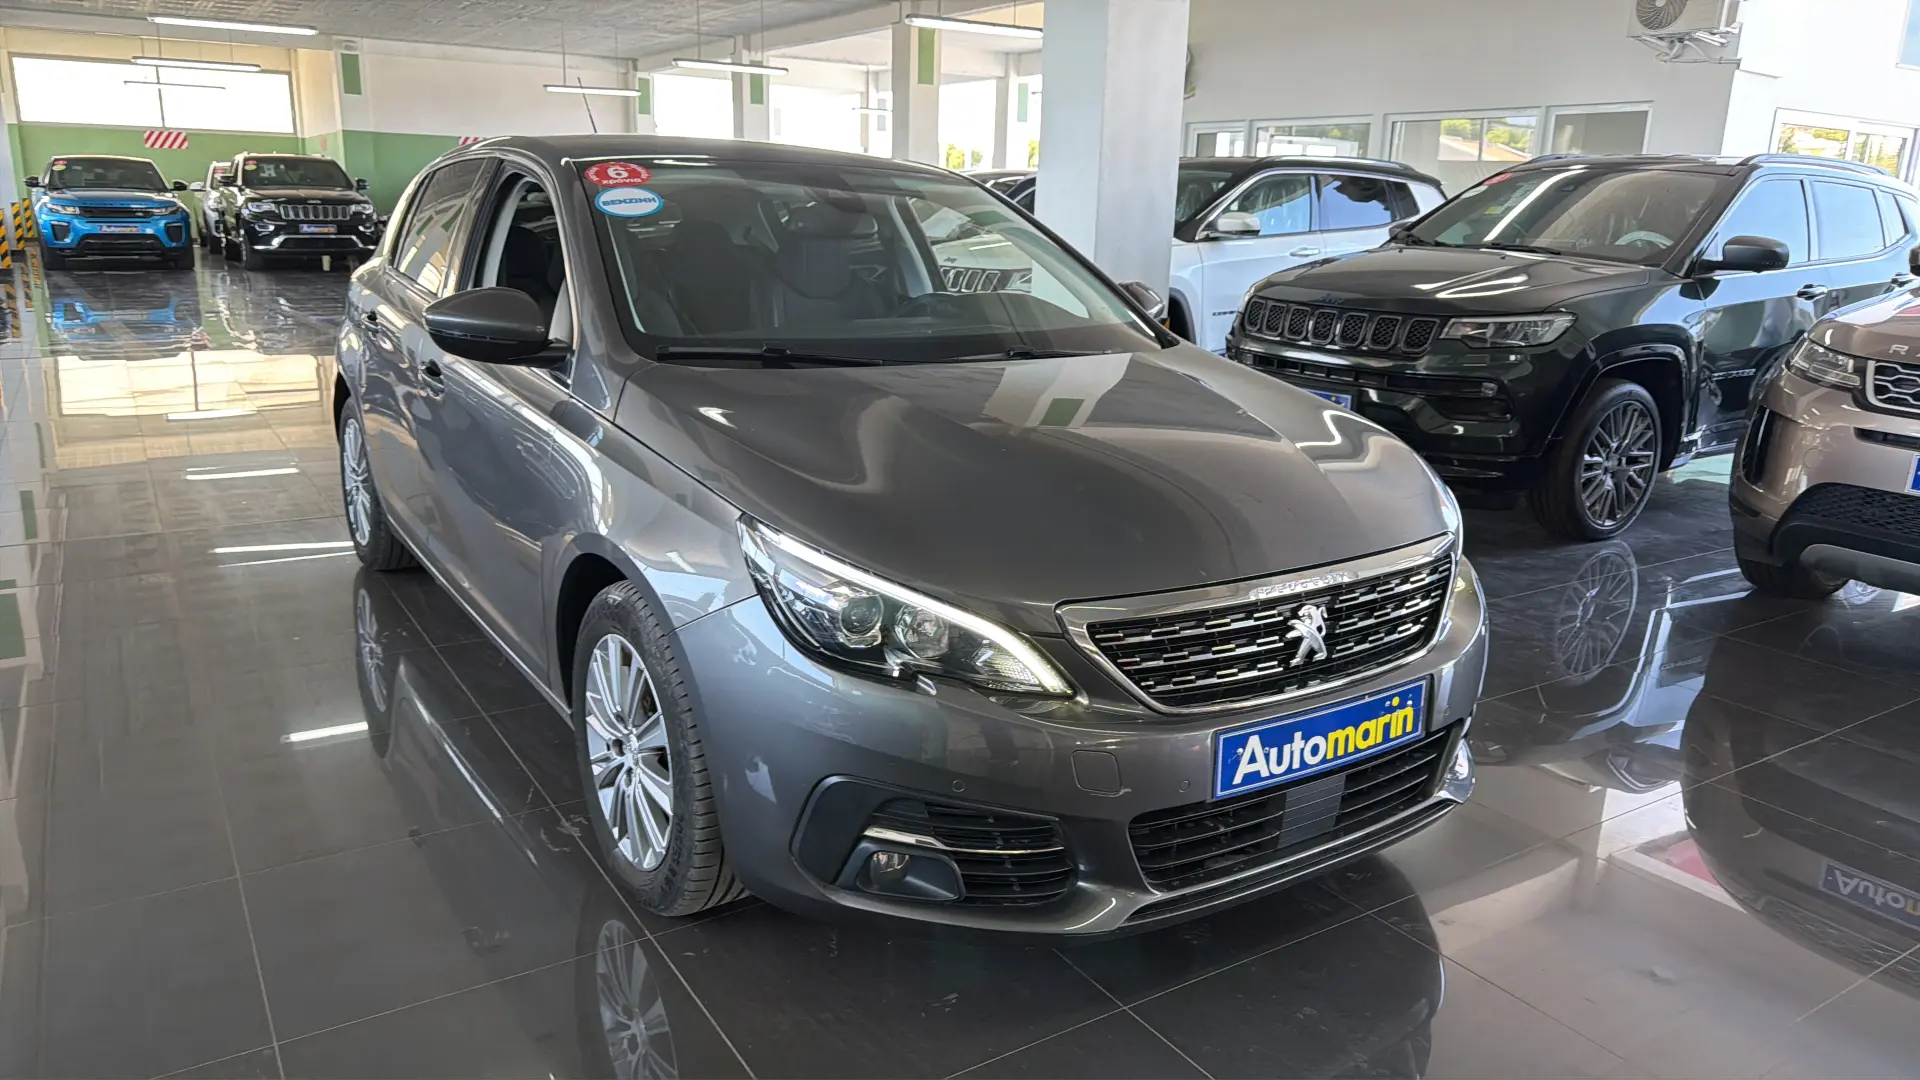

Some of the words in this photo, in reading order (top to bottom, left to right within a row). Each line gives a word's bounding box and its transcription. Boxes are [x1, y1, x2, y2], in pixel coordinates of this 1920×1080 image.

[607, 166, 629, 179] 6
[601, 177, 642, 185] χρόνια
[1232, 696, 1415, 785] Automarin
